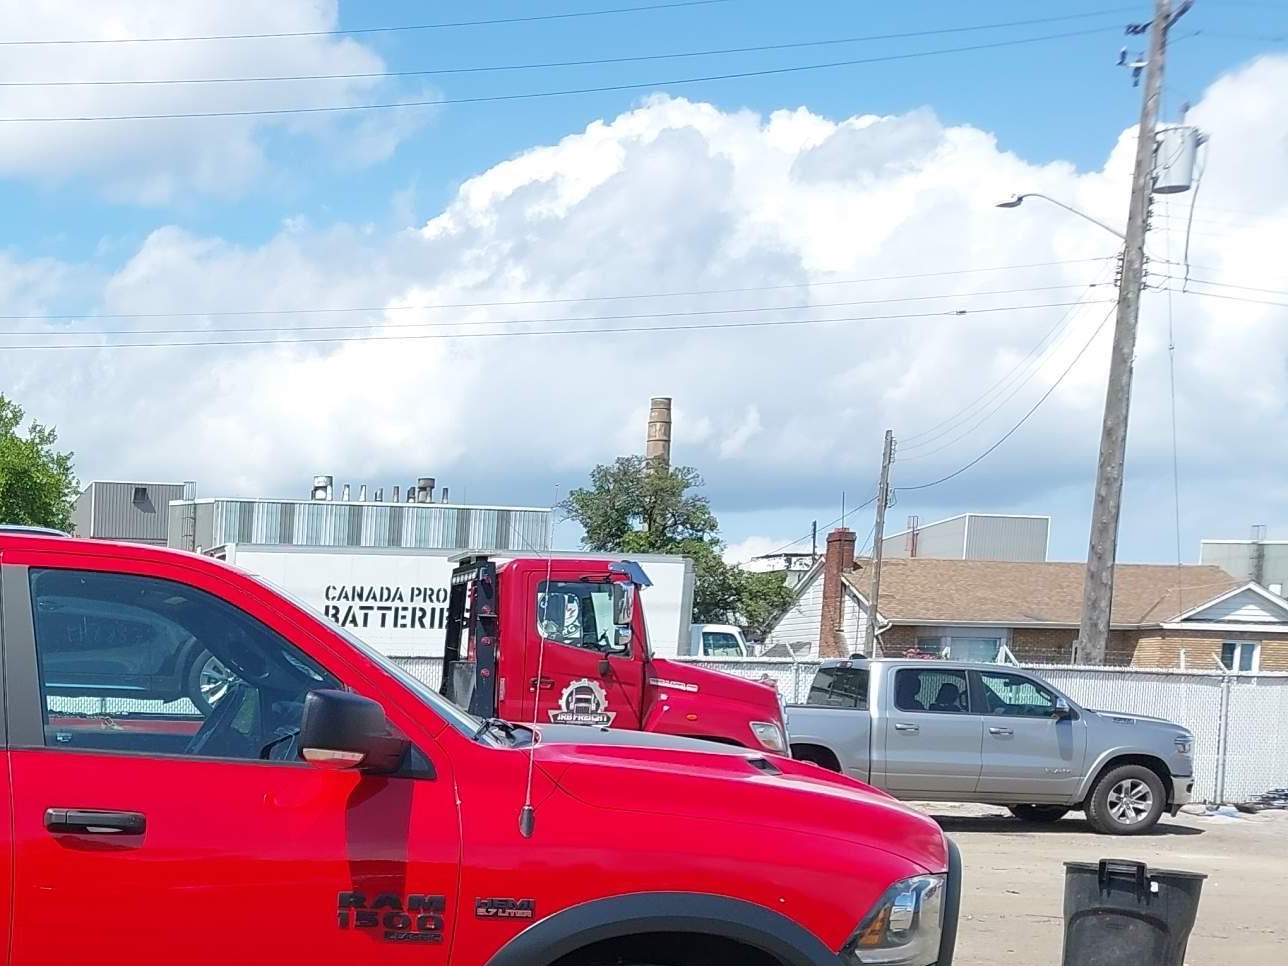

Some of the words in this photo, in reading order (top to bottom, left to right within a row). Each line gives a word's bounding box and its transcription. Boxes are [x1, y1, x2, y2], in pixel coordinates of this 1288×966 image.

[325, 585, 404, 602] CANADA
[410, 587, 448, 603] PRO
[324, 605, 469, 629] BATTERIE
[573, 714, 607, 722] FREIGHT
[338, 891, 446, 911] RAM
[475, 897, 535, 910] HEMI
[337, 910, 444, 930] 1500
[477, 908, 497, 916] 5.7
